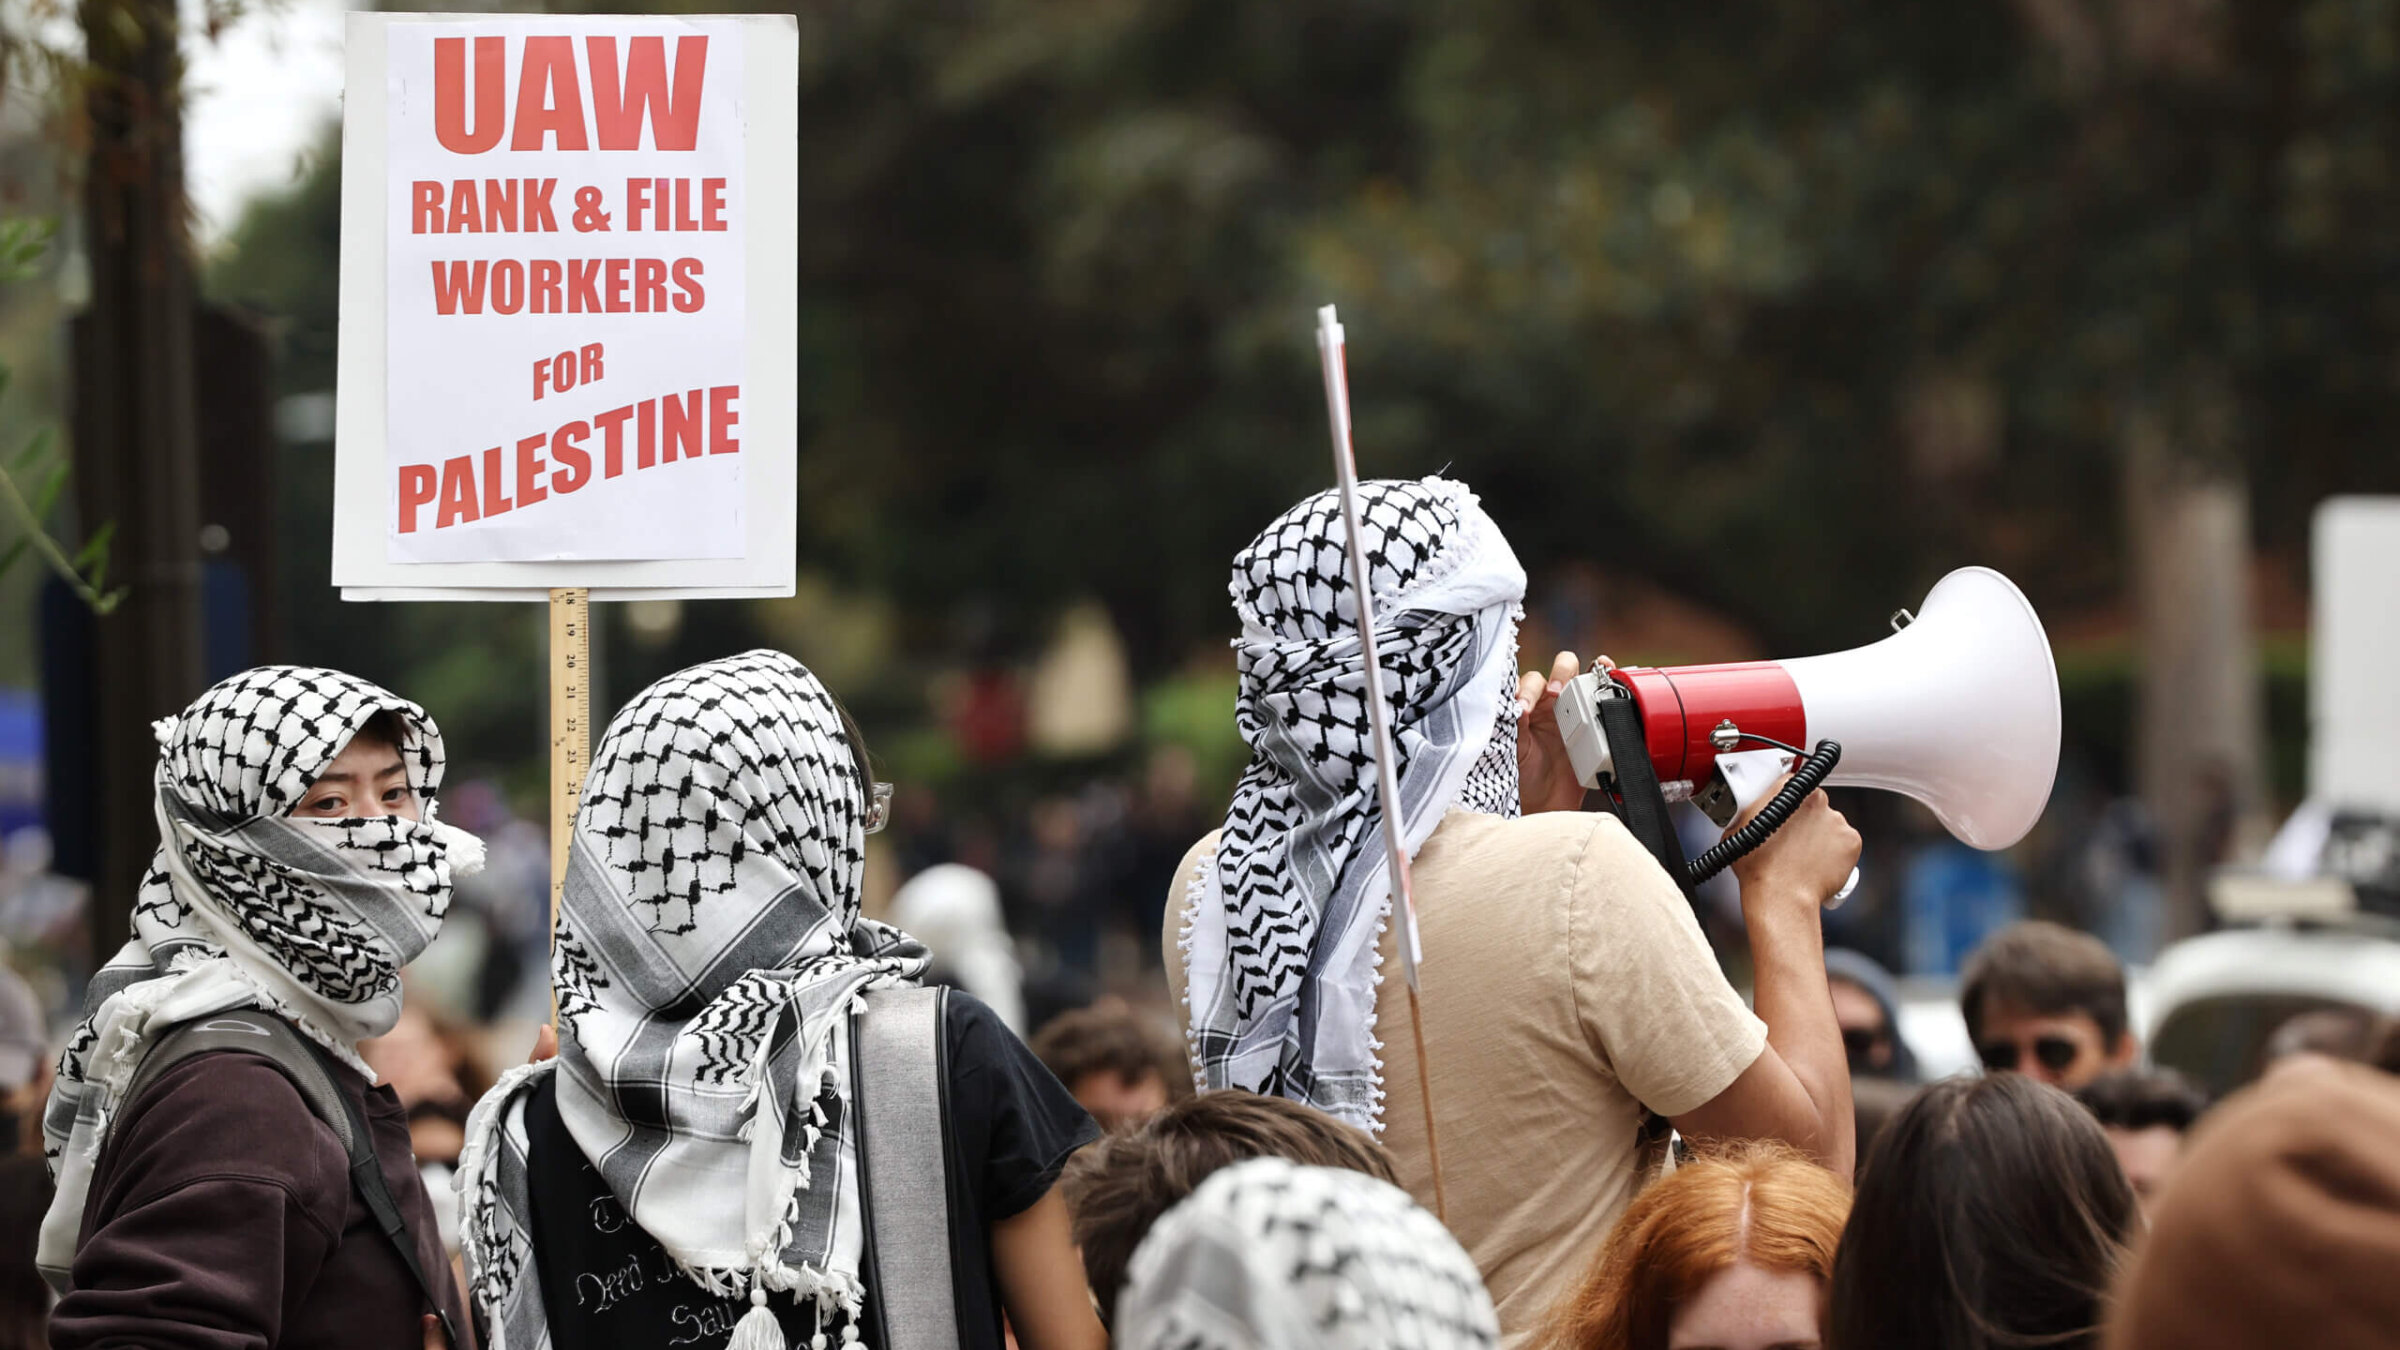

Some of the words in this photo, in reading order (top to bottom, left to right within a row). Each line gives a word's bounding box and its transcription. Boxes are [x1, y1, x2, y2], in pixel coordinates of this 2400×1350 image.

[435, 36, 708, 154] UAW
[413, 178, 558, 234] RANK
[573, 186, 610, 233] &
[628, 178, 727, 231] FILE
[432, 258, 704, 315] WORKERS
[534, 343, 603, 400] FOR
[398, 385, 740, 534] PALESTINE
[565, 591, 574, 604] 18
[566, 623, 574, 636] 19
[566, 654, 575, 668] 20
[566, 686, 575, 698] 21
[566, 718, 575, 731] 22
[567, 750, 576, 763] 23
[567, 782, 576, 795] 24
